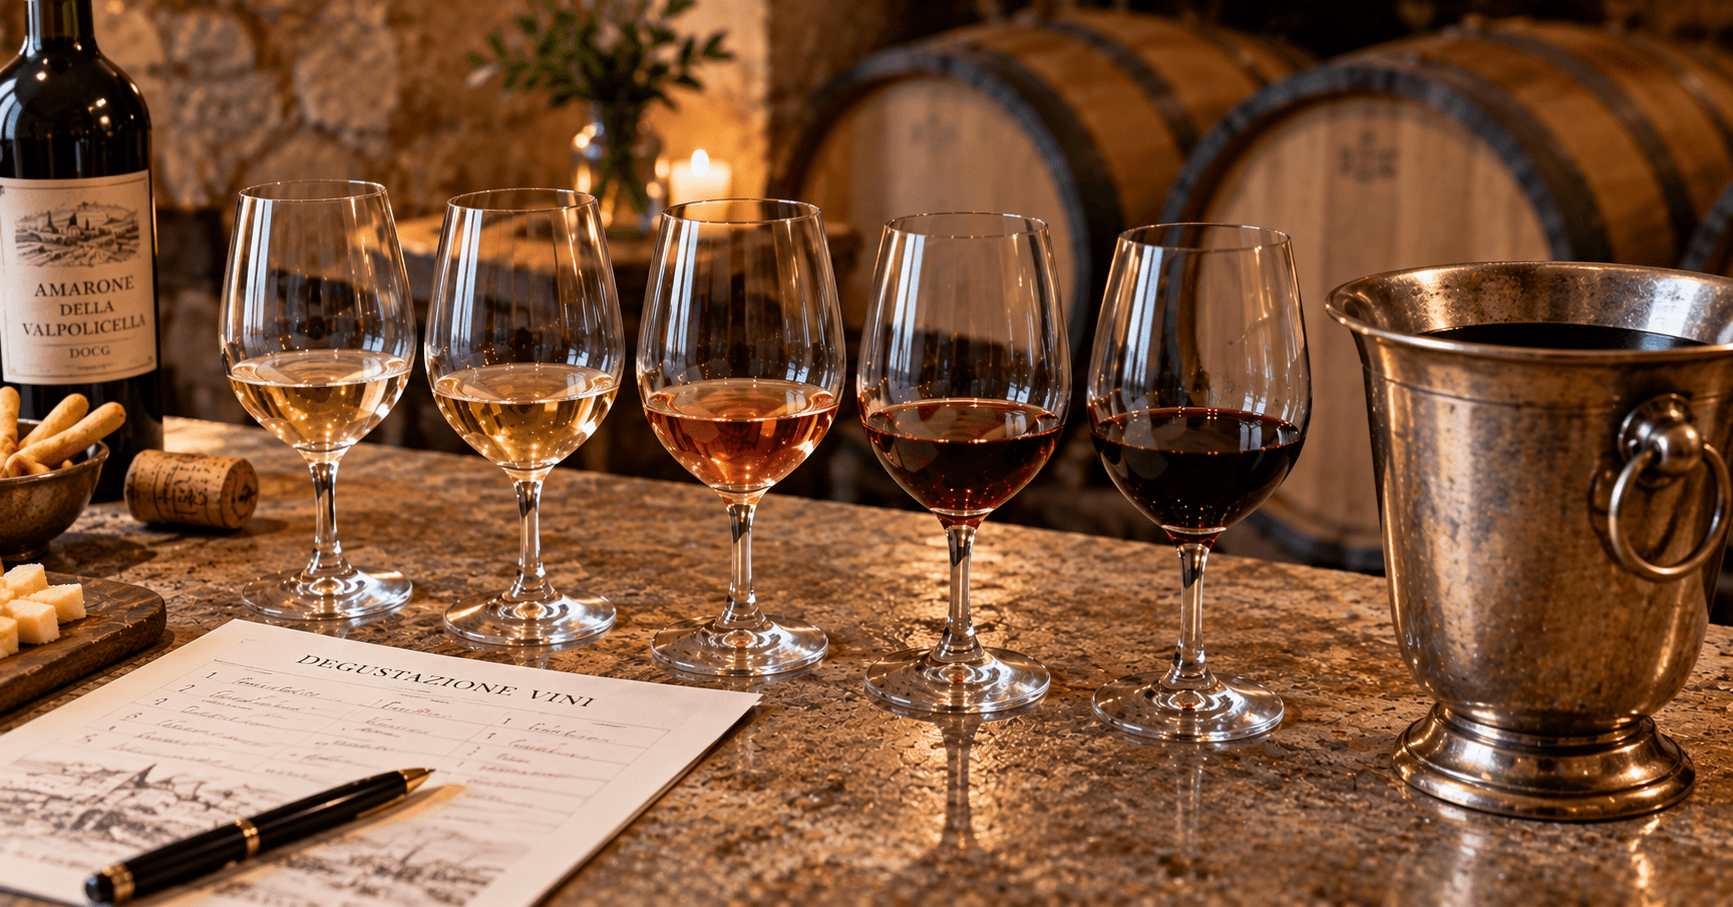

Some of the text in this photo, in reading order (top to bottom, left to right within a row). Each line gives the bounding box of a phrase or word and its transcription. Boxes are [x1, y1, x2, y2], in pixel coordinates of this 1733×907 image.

[34, 275, 135, 297] AMARONE
[60, 300, 115, 317] DELLA
[22, 313, 146, 337] VALPOLICELLA
[69, 345, 110, 358] DOCG
[296, 654, 518, 697] DEGUSTAZIONE
[530, 688, 597, 708] VINI
